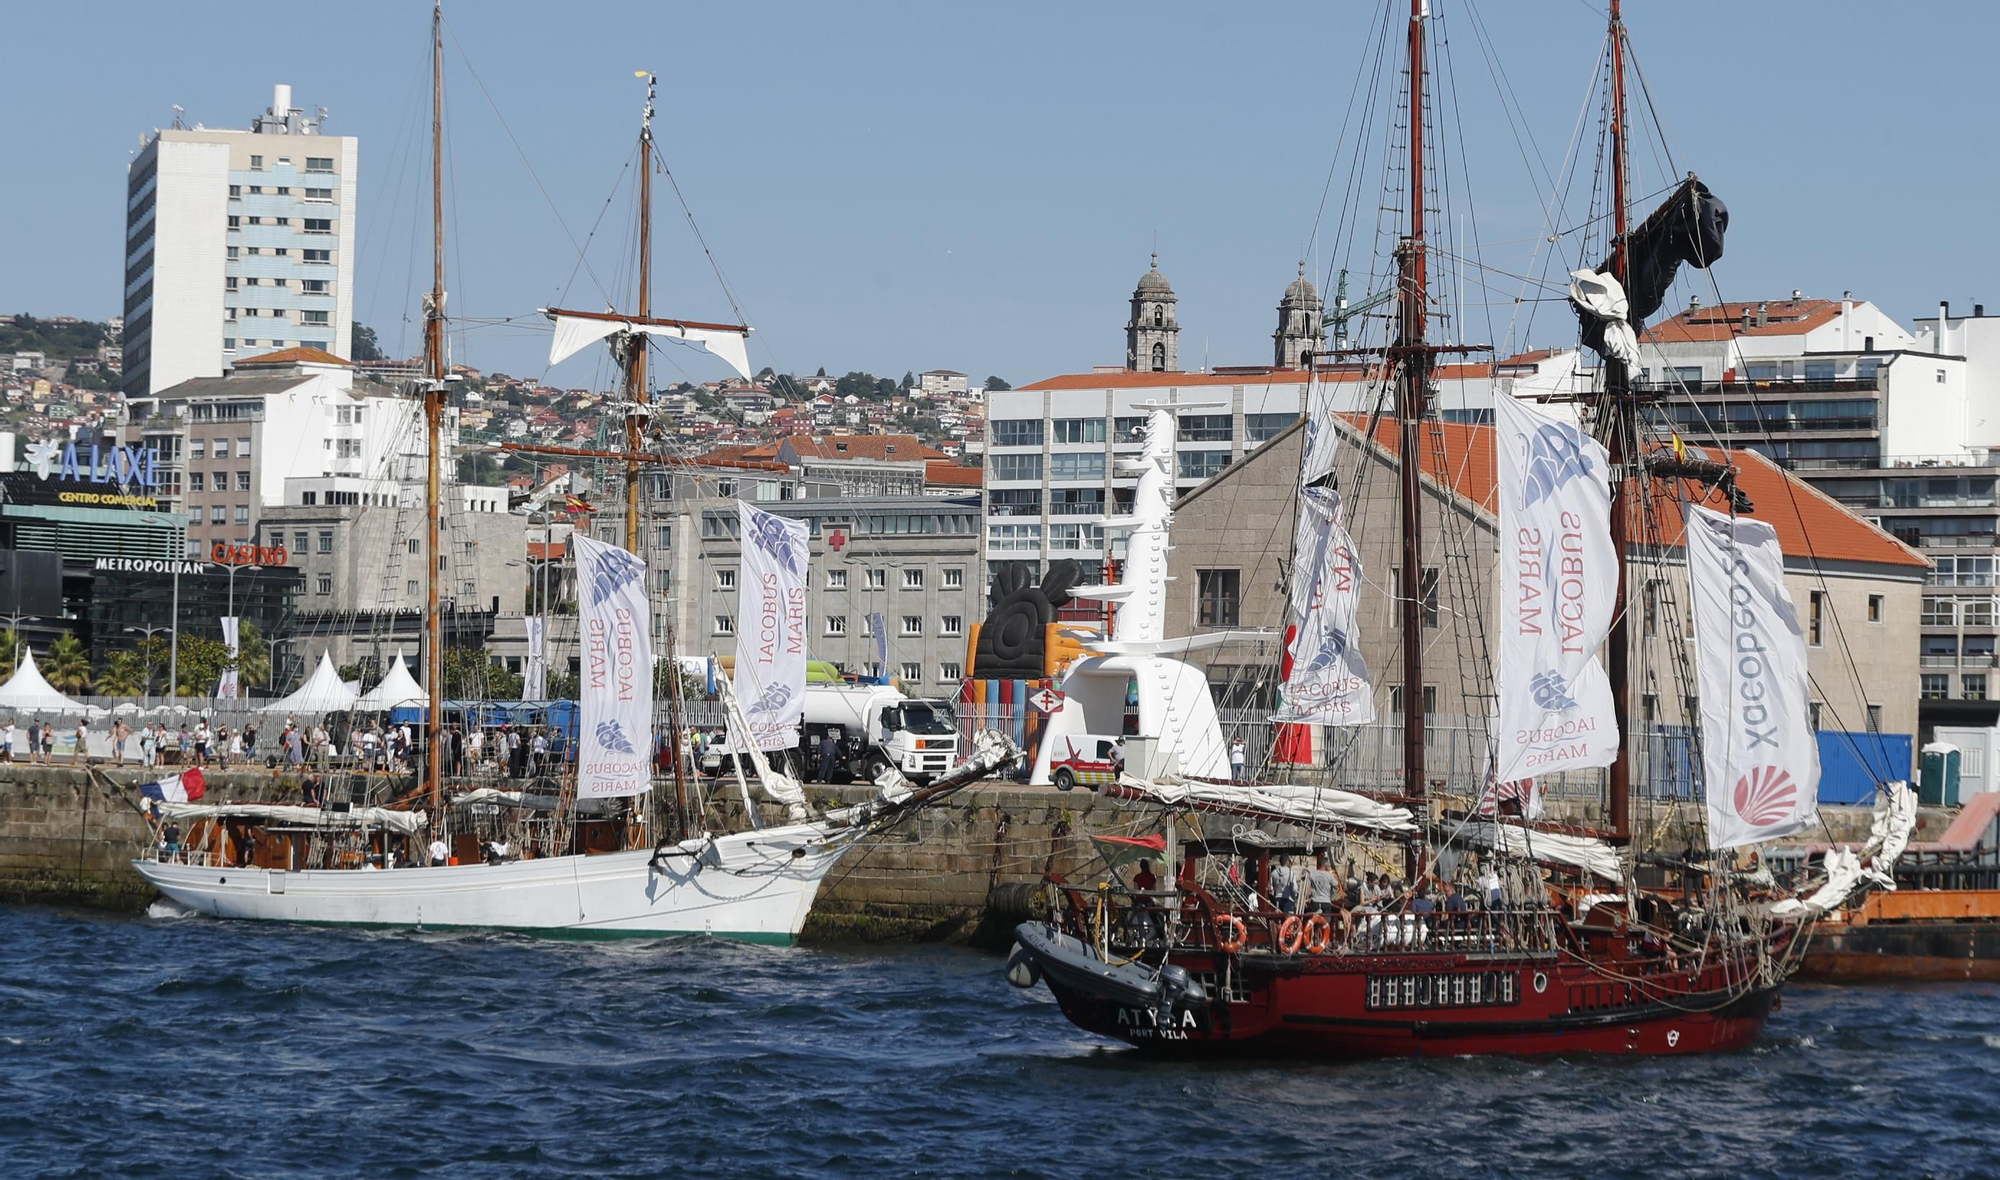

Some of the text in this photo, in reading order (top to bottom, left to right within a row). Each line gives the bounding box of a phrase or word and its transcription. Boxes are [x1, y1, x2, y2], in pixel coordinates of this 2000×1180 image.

[60, 442, 162, 487] A LAXE
[59, 492, 158, 507] CENTRO COMERCIAL
[95, 557, 204, 575] METROPOLITAN
[212, 543, 288, 567] CASINO
[758, 573, 778, 665] IACOBUS
[786, 587, 803, 655] MARIS
[1130, 1028, 1188, 1040] PORT VILA
